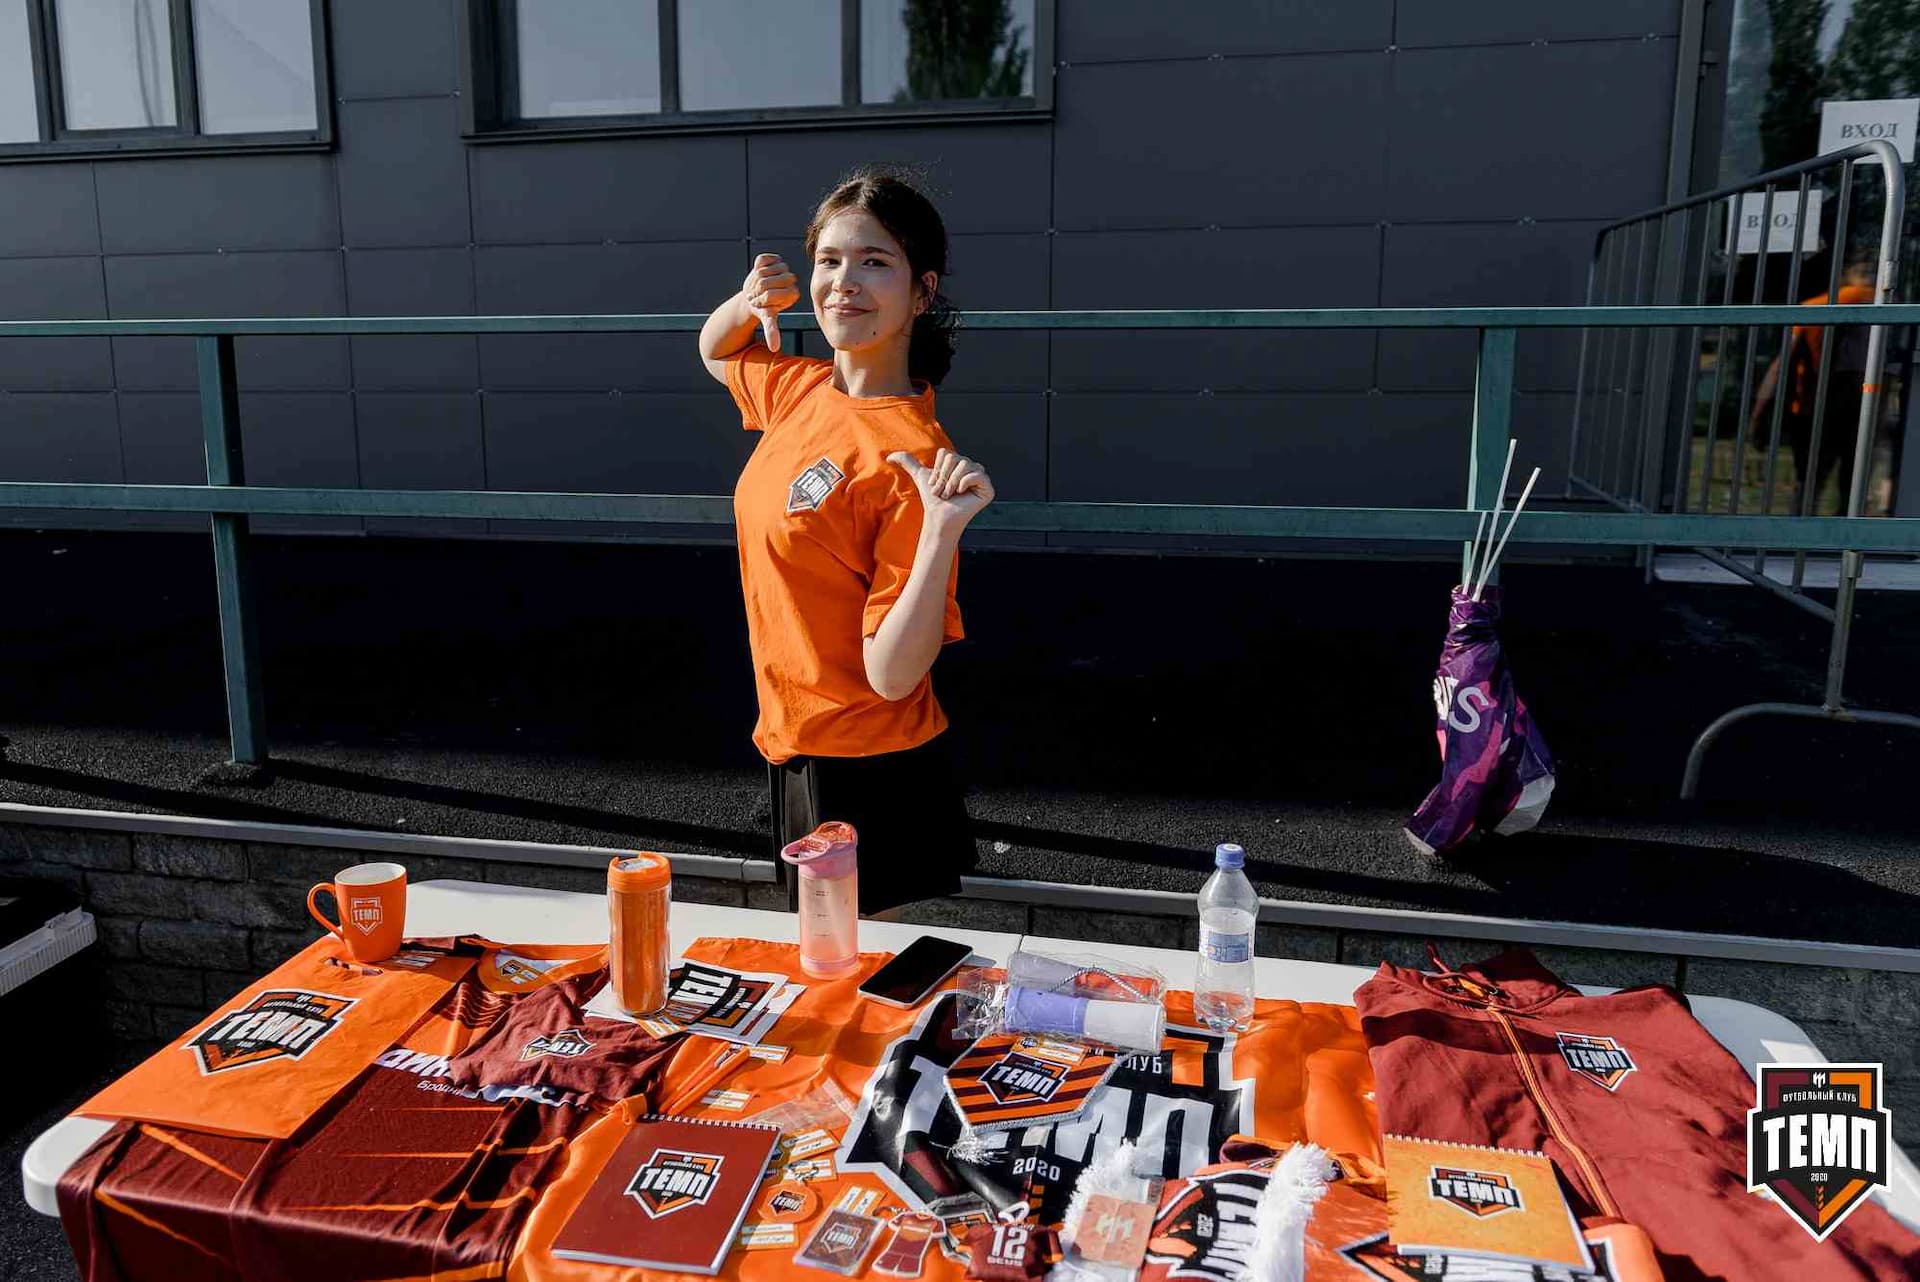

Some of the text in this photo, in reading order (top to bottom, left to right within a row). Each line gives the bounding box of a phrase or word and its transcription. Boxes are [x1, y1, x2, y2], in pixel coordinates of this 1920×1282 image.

[1842, 122, 1898, 138] ВХОД
[1746, 213, 1800, 229] ВО
[797, 470, 829, 503] ТЕМП
[353, 908, 380, 921] ТЕМП
[208, 1009, 327, 1050] ТЕМП
[1117, 1054, 1162, 1074] ЛУБ
[1566, 1049, 1627, 1068] ТЕМП
[991, 1065, 1056, 1095] ТЕМП
[1012, 1156, 1061, 1181] 2020
[640, 1167, 710, 1197] ТЕМП
[1436, 1179, 1514, 1206] ТЕМП
[827, 1230, 855, 1247] ТЕМП
[992, 1224, 1028, 1259] 12
